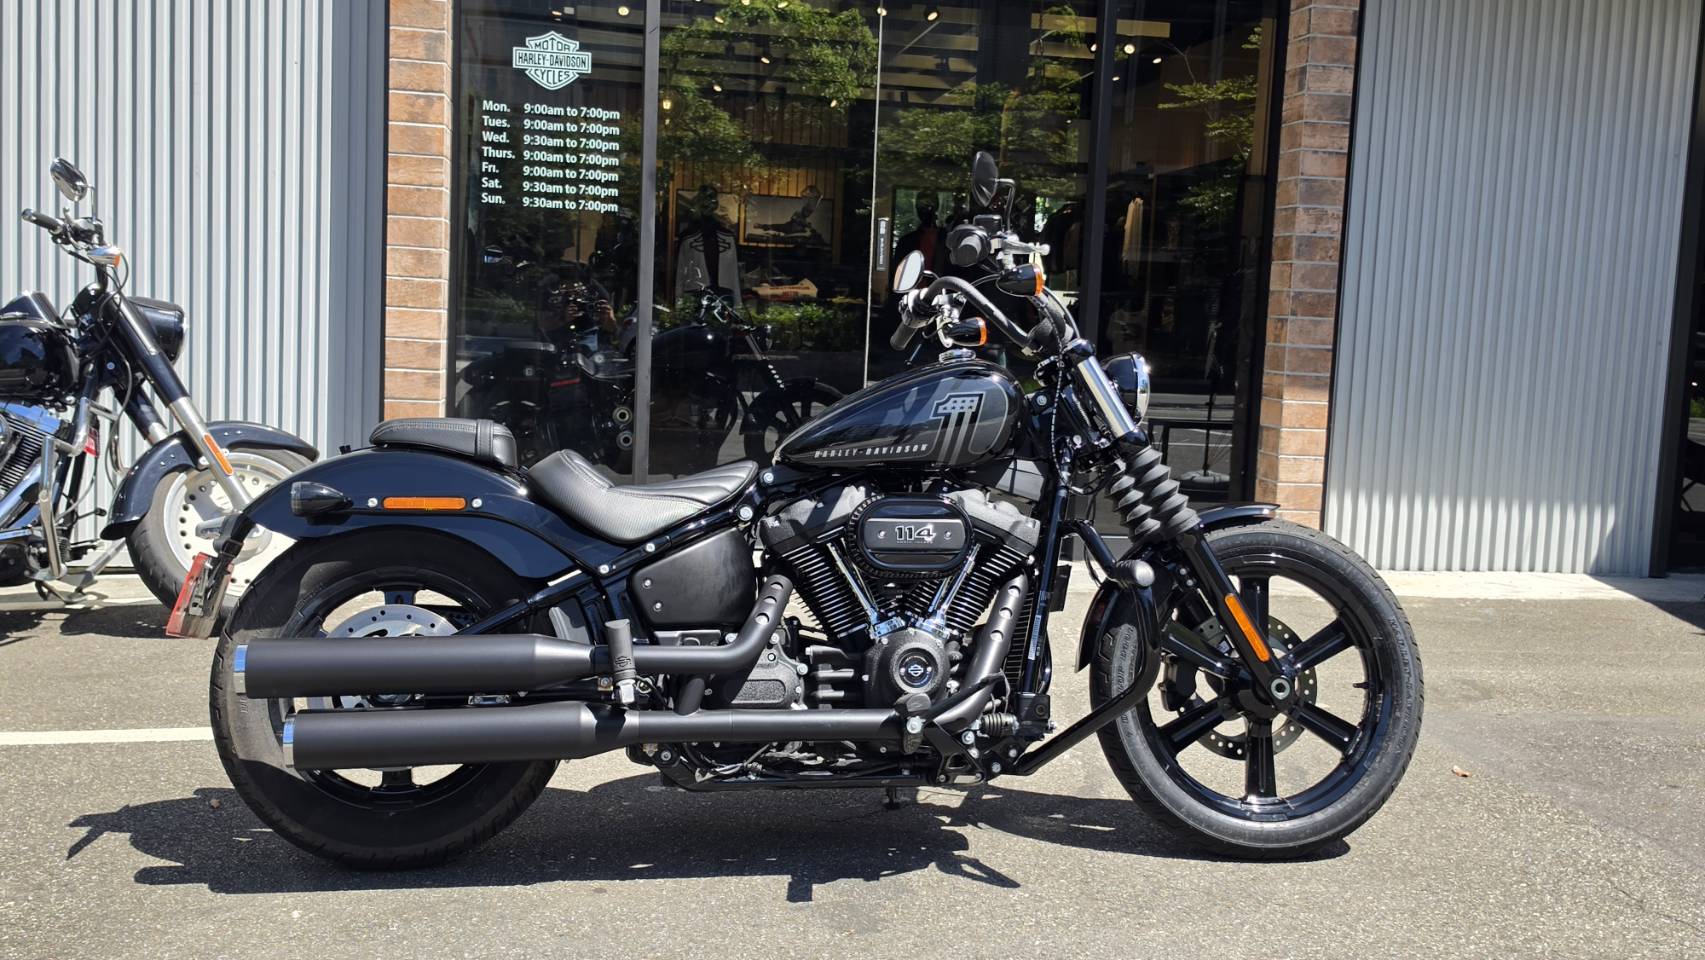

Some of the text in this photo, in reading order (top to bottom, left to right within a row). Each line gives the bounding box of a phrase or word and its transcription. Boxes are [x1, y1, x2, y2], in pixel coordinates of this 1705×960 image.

[535, 38, 570, 52] MOTOR
[518, 52, 586, 68] HARLEY-DAVIDSON
[535, 69, 570, 84] CYCLES
[483, 100, 620, 121] Mon. 9:00am to 7:00pm
[482, 116, 619, 136] Tues. 9:00am to 7:00pm
[482, 131, 619, 152] Wed. 9:30am to 7:00pm
[482, 146, 619, 167] Thurs. 9:00am to 7:00pm
[482, 162, 618, 182] Fri. 9:00am to 7:00pm
[482, 177, 618, 198] Sat. 9:30am to 7:00pm
[482, 193, 618, 213] Sun. 9:30am to 7:00pm
[815, 444, 928, 458] HARLEY-DAVIDSON
[895, 524, 936, 541] 114
